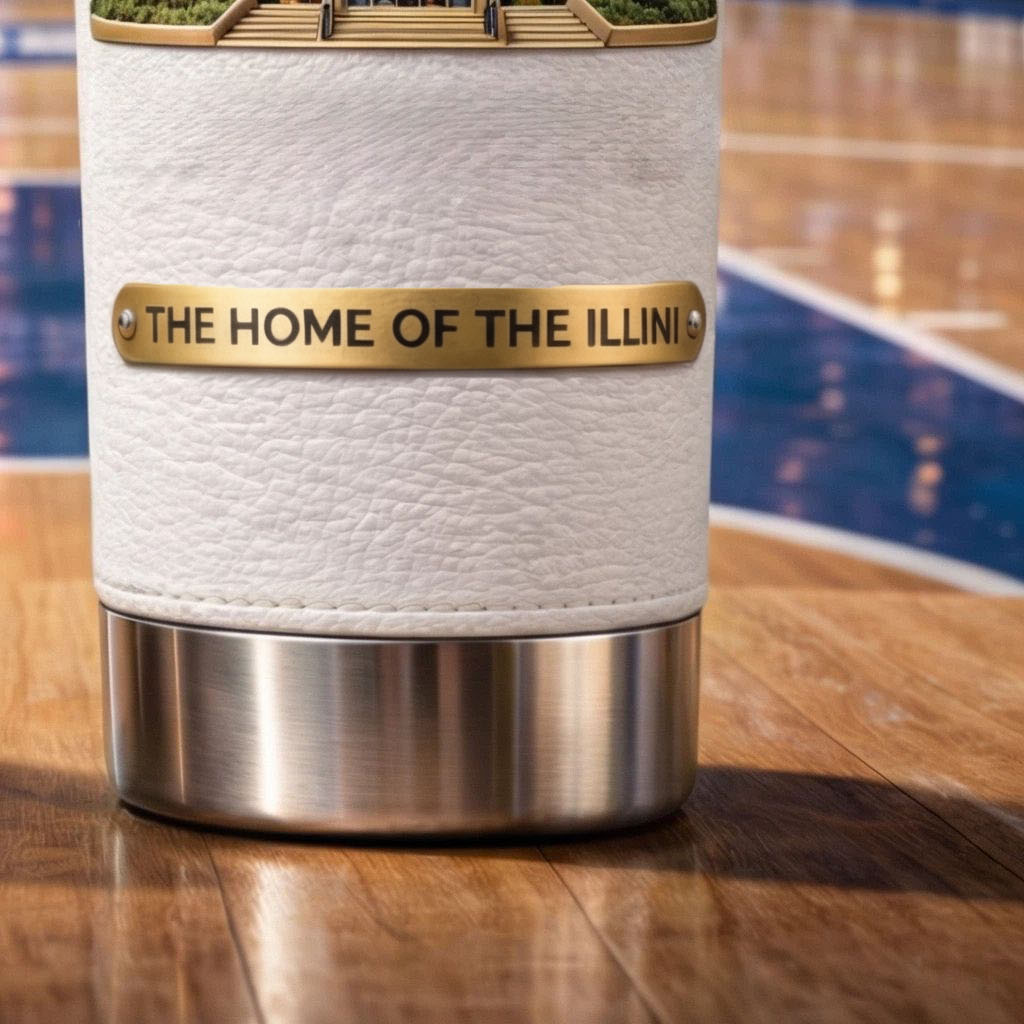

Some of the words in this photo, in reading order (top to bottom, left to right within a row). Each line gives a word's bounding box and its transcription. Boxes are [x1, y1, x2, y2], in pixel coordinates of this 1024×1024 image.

[145, 305, 215, 345] THE
[230, 306, 375, 348] HOME
[391, 307, 461, 349] OF
[474, 307, 571, 349] THE
[586, 306, 680, 349] ILLINI
